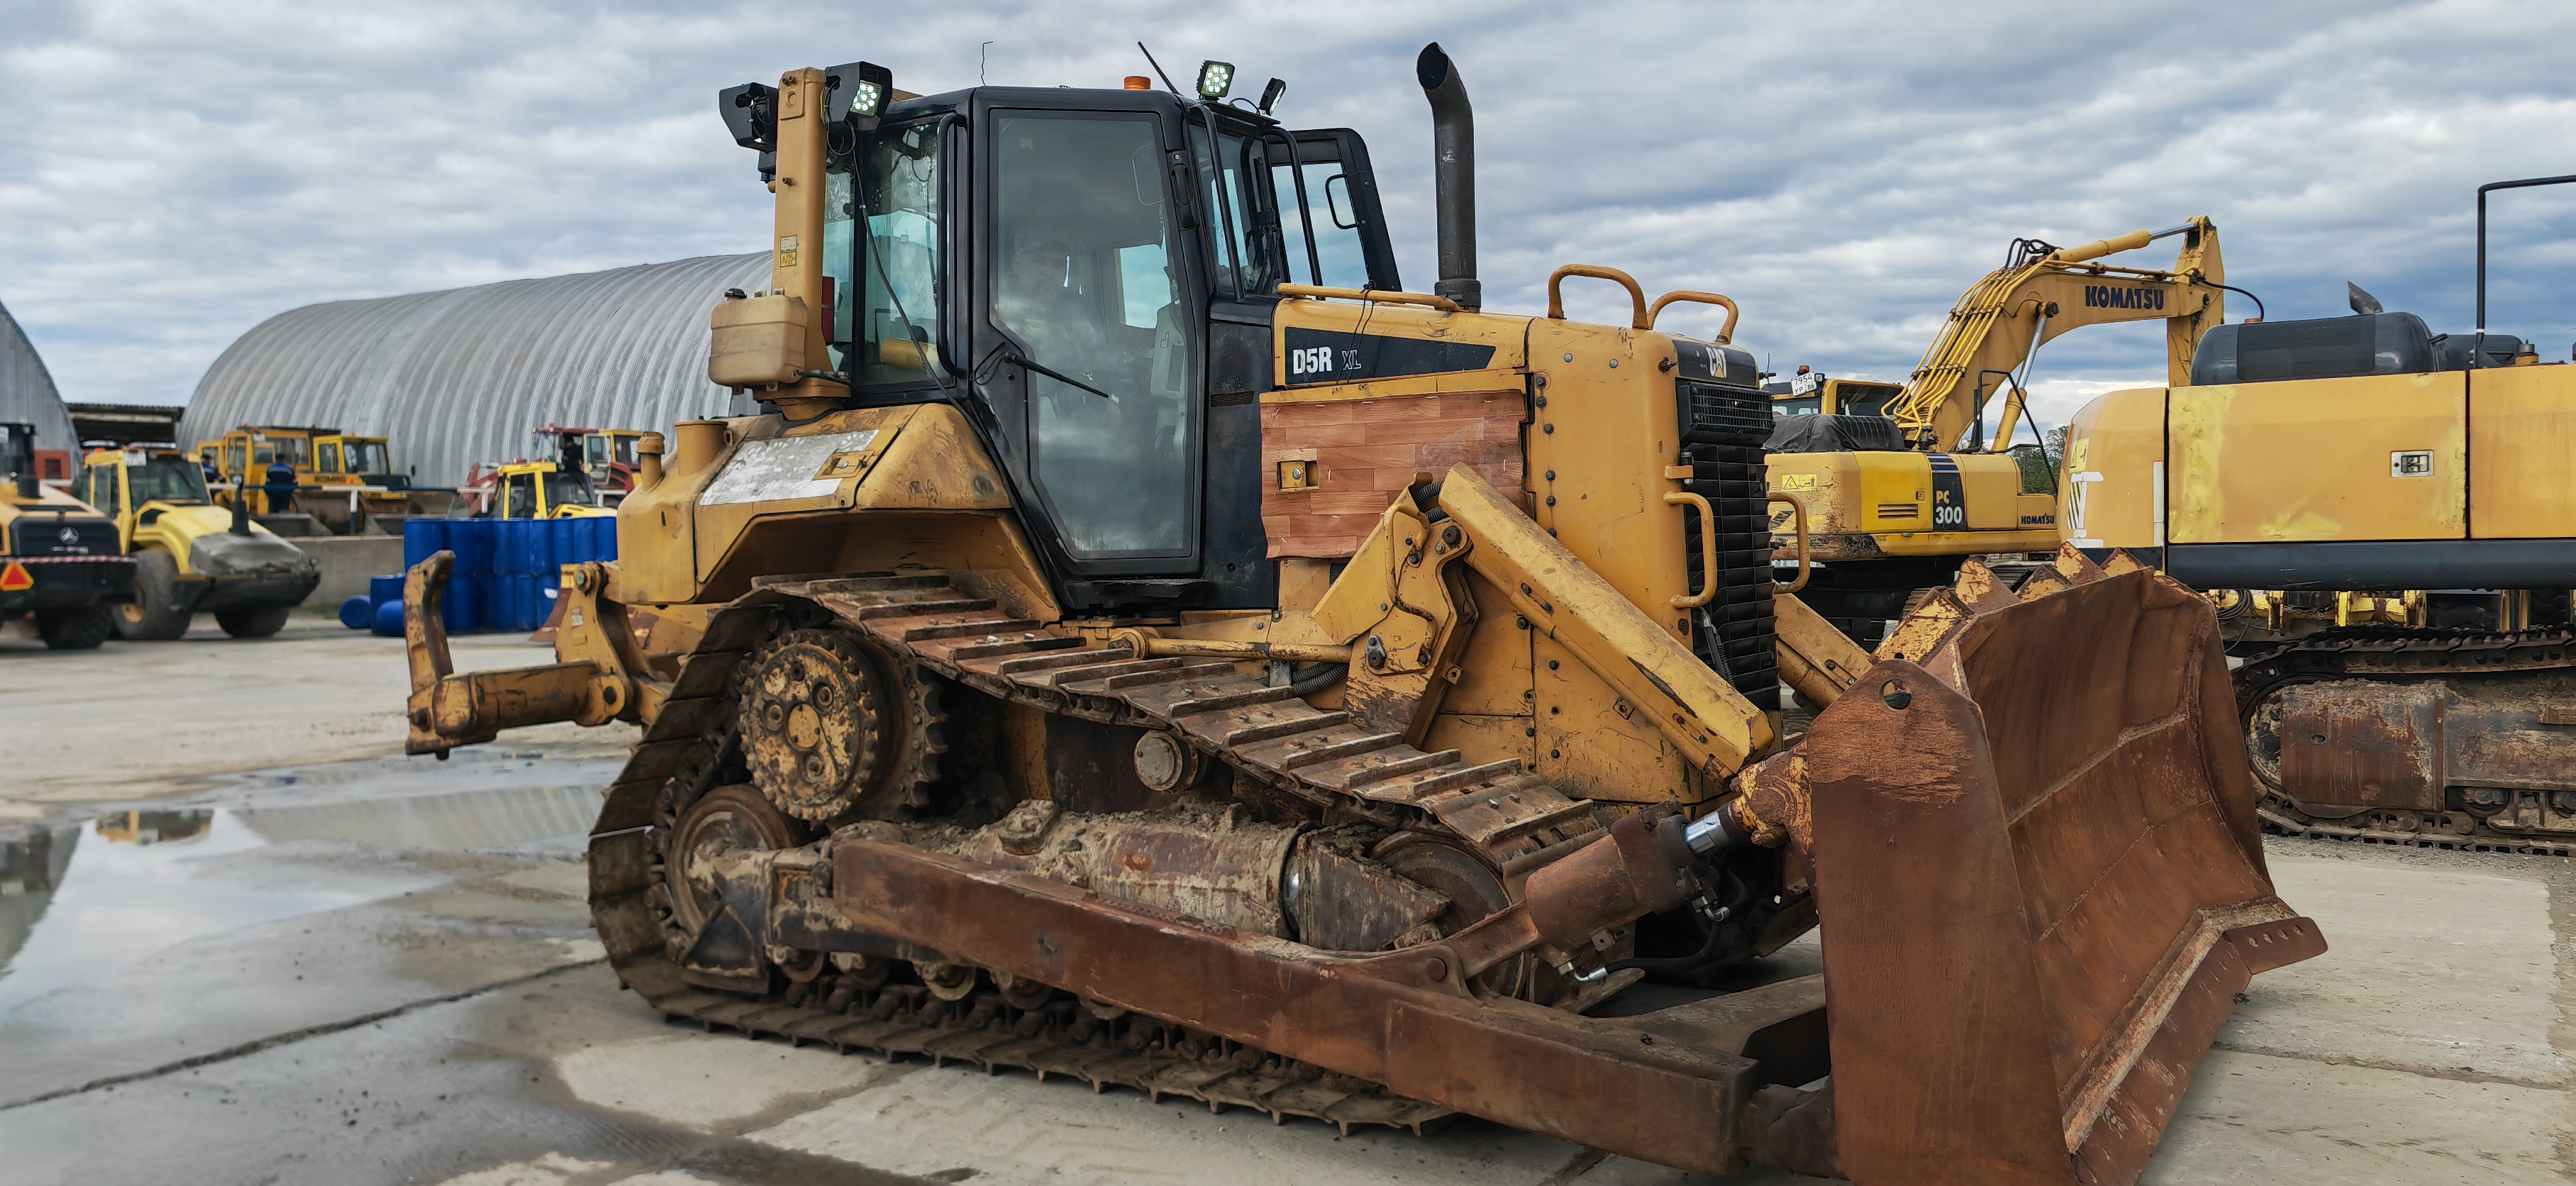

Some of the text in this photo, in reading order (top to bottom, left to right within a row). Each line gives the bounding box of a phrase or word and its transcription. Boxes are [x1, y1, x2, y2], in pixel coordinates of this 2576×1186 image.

[2085, 286, 2164, 310] KOMATSU
[1293, 347, 1361, 374] D5R XL
[1705, 346, 1727, 378] CAT
[1793, 373, 1813, 386] 7954
[1936, 490, 1950, 504] PC
[1935, 506, 1963, 524] 300
[2021, 514, 2055, 525] KOMATSU
